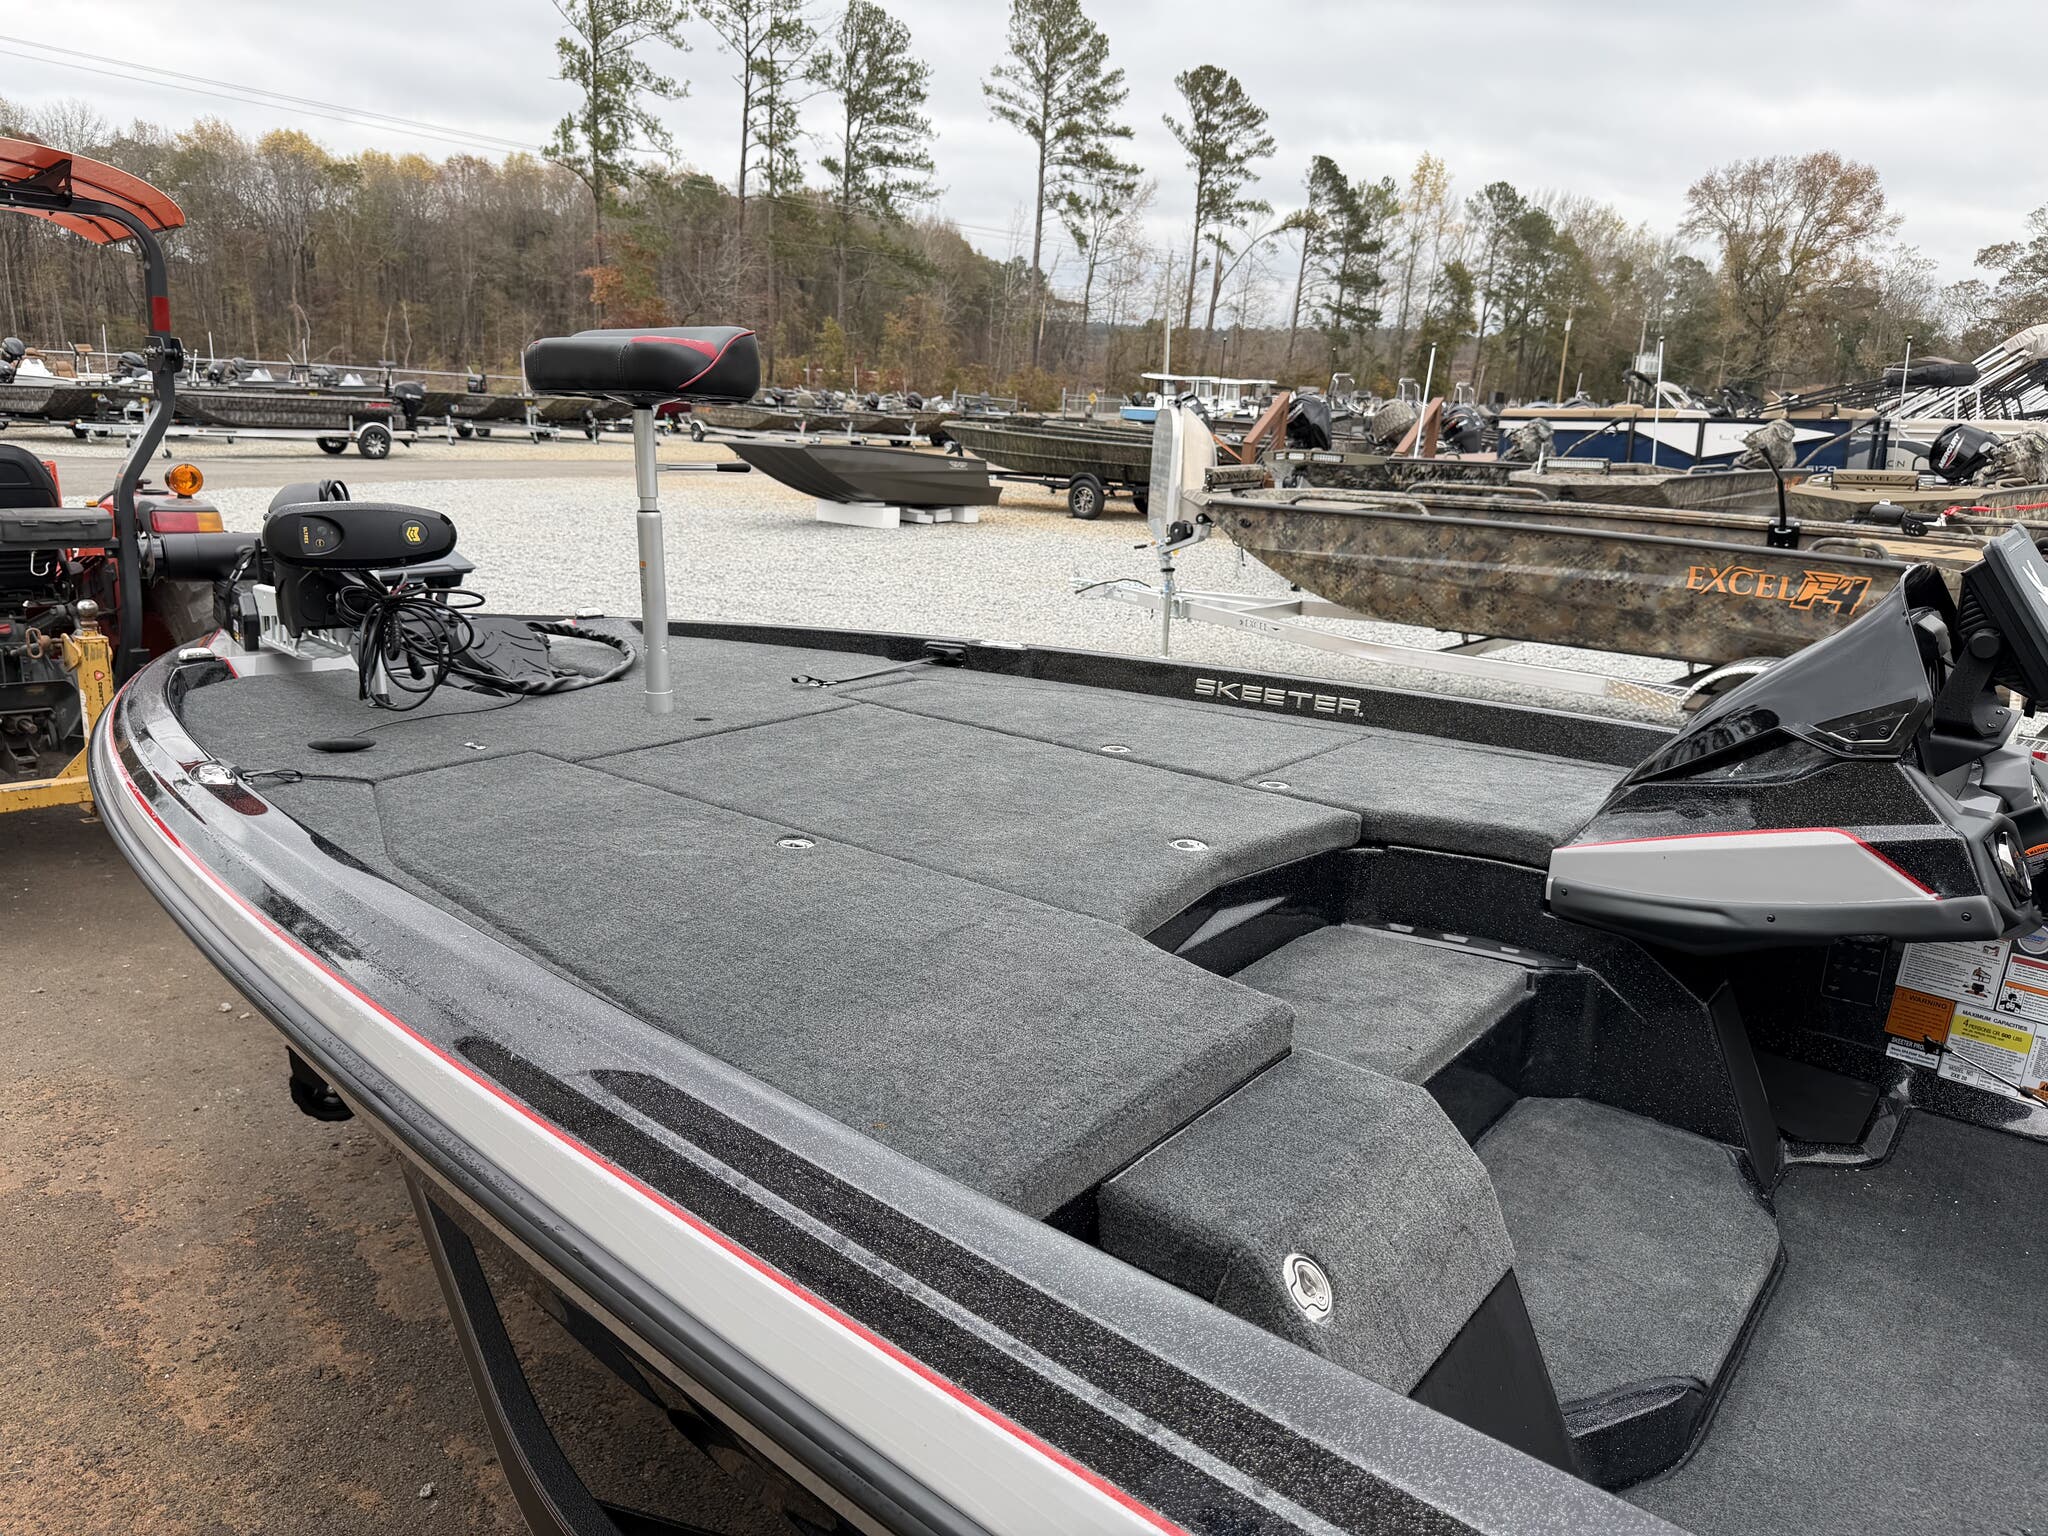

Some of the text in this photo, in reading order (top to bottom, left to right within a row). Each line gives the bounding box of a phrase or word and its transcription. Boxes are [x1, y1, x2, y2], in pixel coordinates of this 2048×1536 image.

[1938, 432, 1960, 469] MERCURY
[1686, 564, 1798, 601] EXCEL
[1194, 678, 1363, 717] SKEETER
[1909, 994, 1948, 1010] WARNING
[1962, 1010, 2028, 1032] MAXIMUM CAPACITIES
